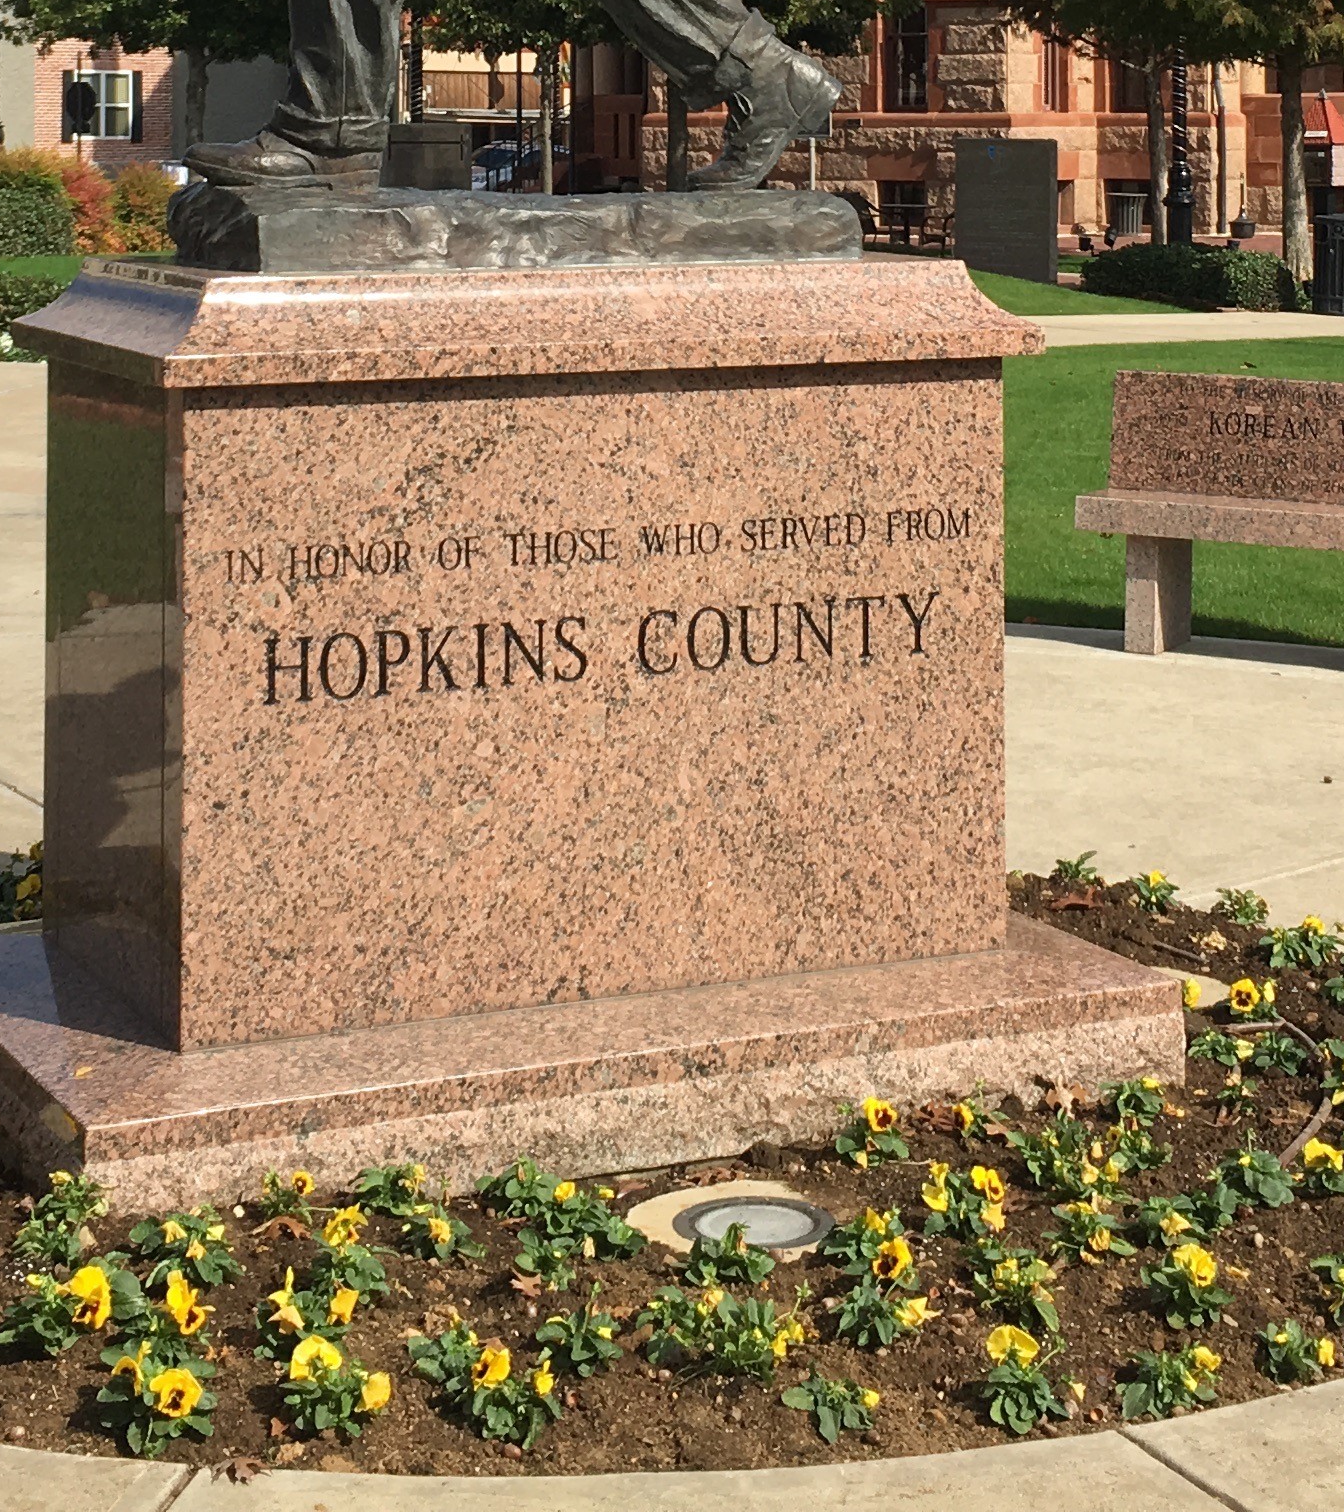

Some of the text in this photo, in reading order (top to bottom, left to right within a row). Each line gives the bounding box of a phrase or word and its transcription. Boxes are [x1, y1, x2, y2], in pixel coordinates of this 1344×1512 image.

[1209, 410, 1320, 440] KOREAN
[225, 506, 972, 583] IN HONOR OF THOSE WHO SERVED FROM
[262, 590, 941, 706] HOPKINS COUNTY
